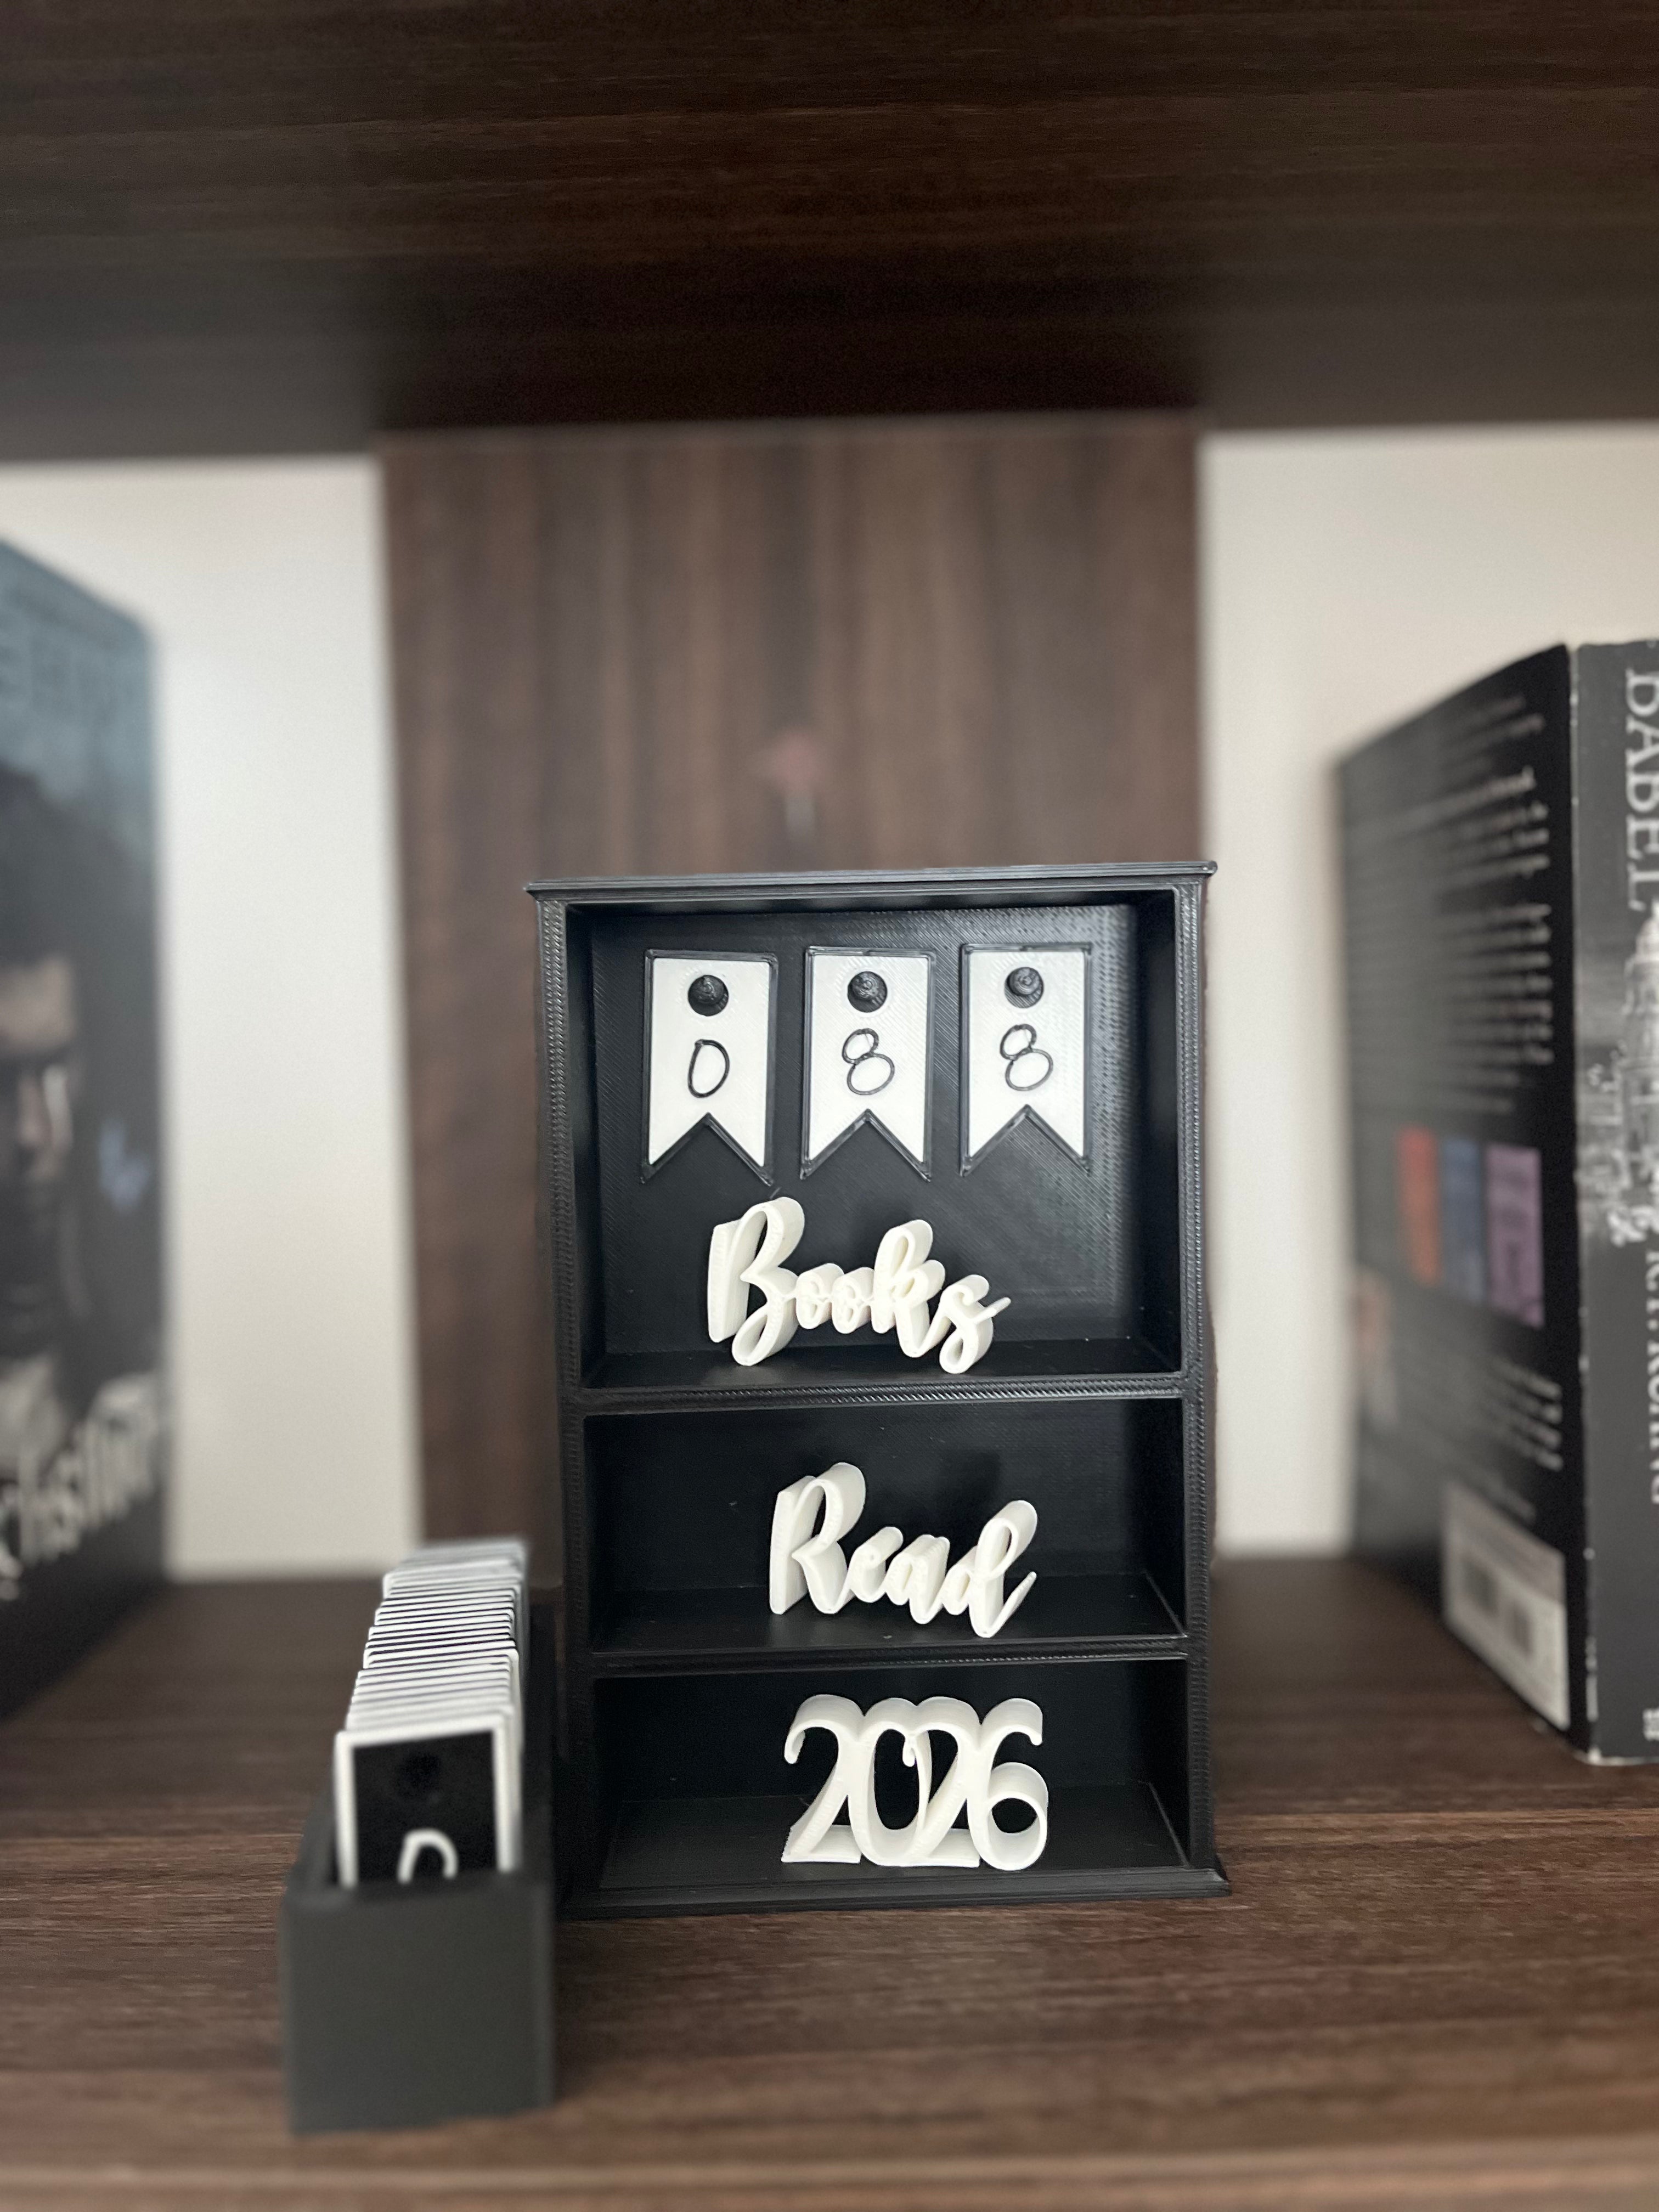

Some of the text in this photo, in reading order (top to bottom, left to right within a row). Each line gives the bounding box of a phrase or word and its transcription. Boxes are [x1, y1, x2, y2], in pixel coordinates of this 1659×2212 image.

[687, 1023, 1053, 1098] 0 8 8
[707, 1197, 1012, 1374] Books
[769, 1462, 1038, 1638] Read
[781, 1694, 1049, 1871] 2026
